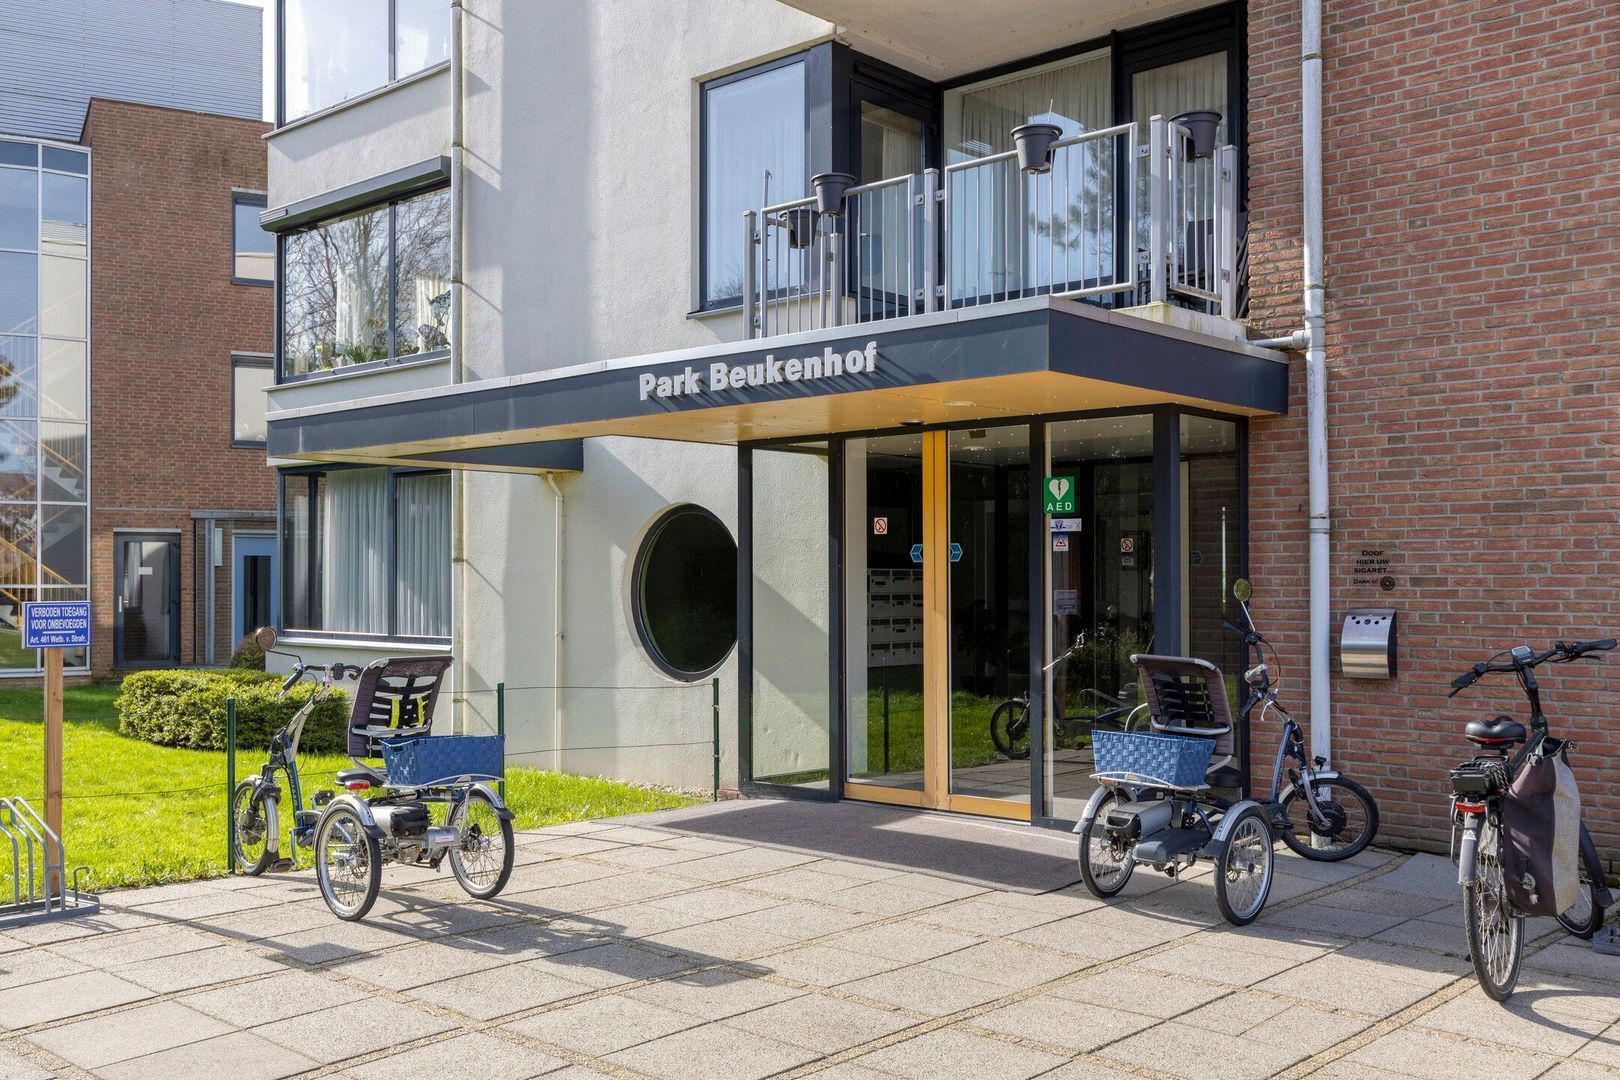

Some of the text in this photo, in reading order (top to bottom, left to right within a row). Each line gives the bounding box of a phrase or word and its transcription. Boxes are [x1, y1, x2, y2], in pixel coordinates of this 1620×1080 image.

[639, 341, 877, 401] Park Beukenhof
[1046, 502, 1072, 511] AED
[31, 607, 87, 617] VERBODEN TOEGANG
[31, 619, 87, 629] VOOR ONBEVOEGDEN
